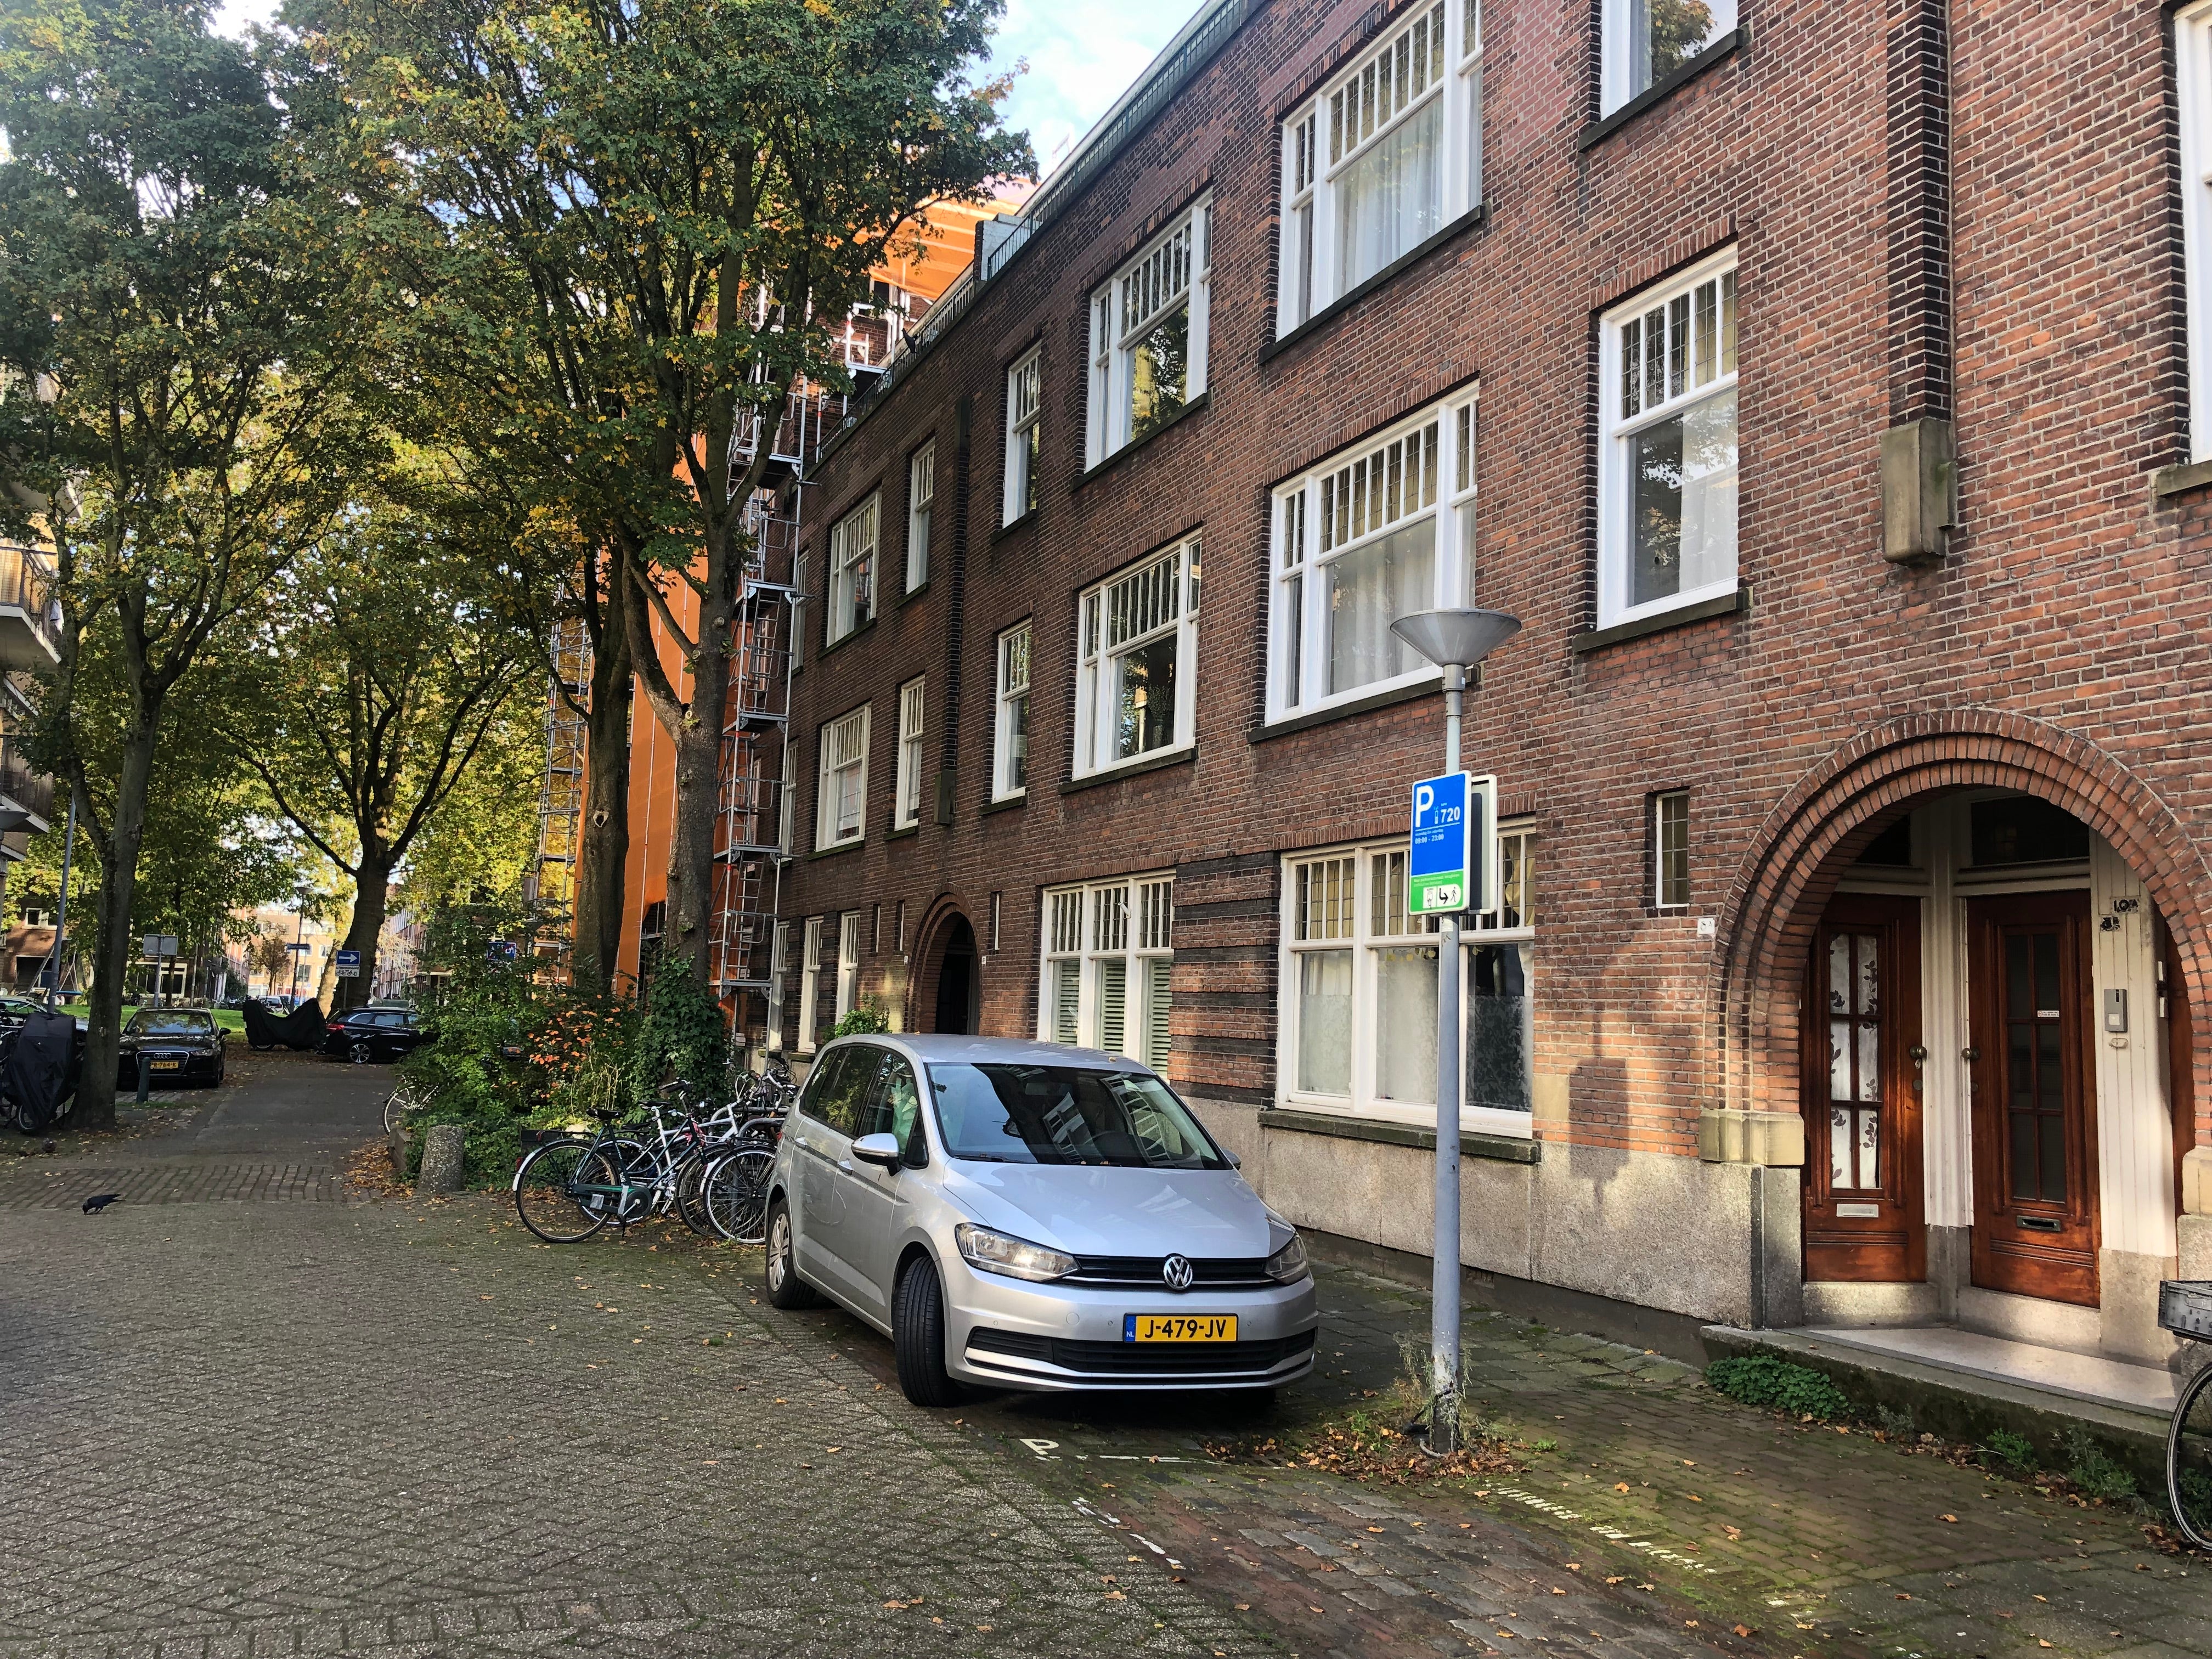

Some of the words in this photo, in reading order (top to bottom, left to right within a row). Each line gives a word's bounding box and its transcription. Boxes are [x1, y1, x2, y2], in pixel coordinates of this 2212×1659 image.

[1415, 785, 1434, 828] P
[1441, 806, 1460, 823] 720
[1144, 1319, 1227, 1339] J-479-JV
[1019, 1438, 1059, 1455] P
